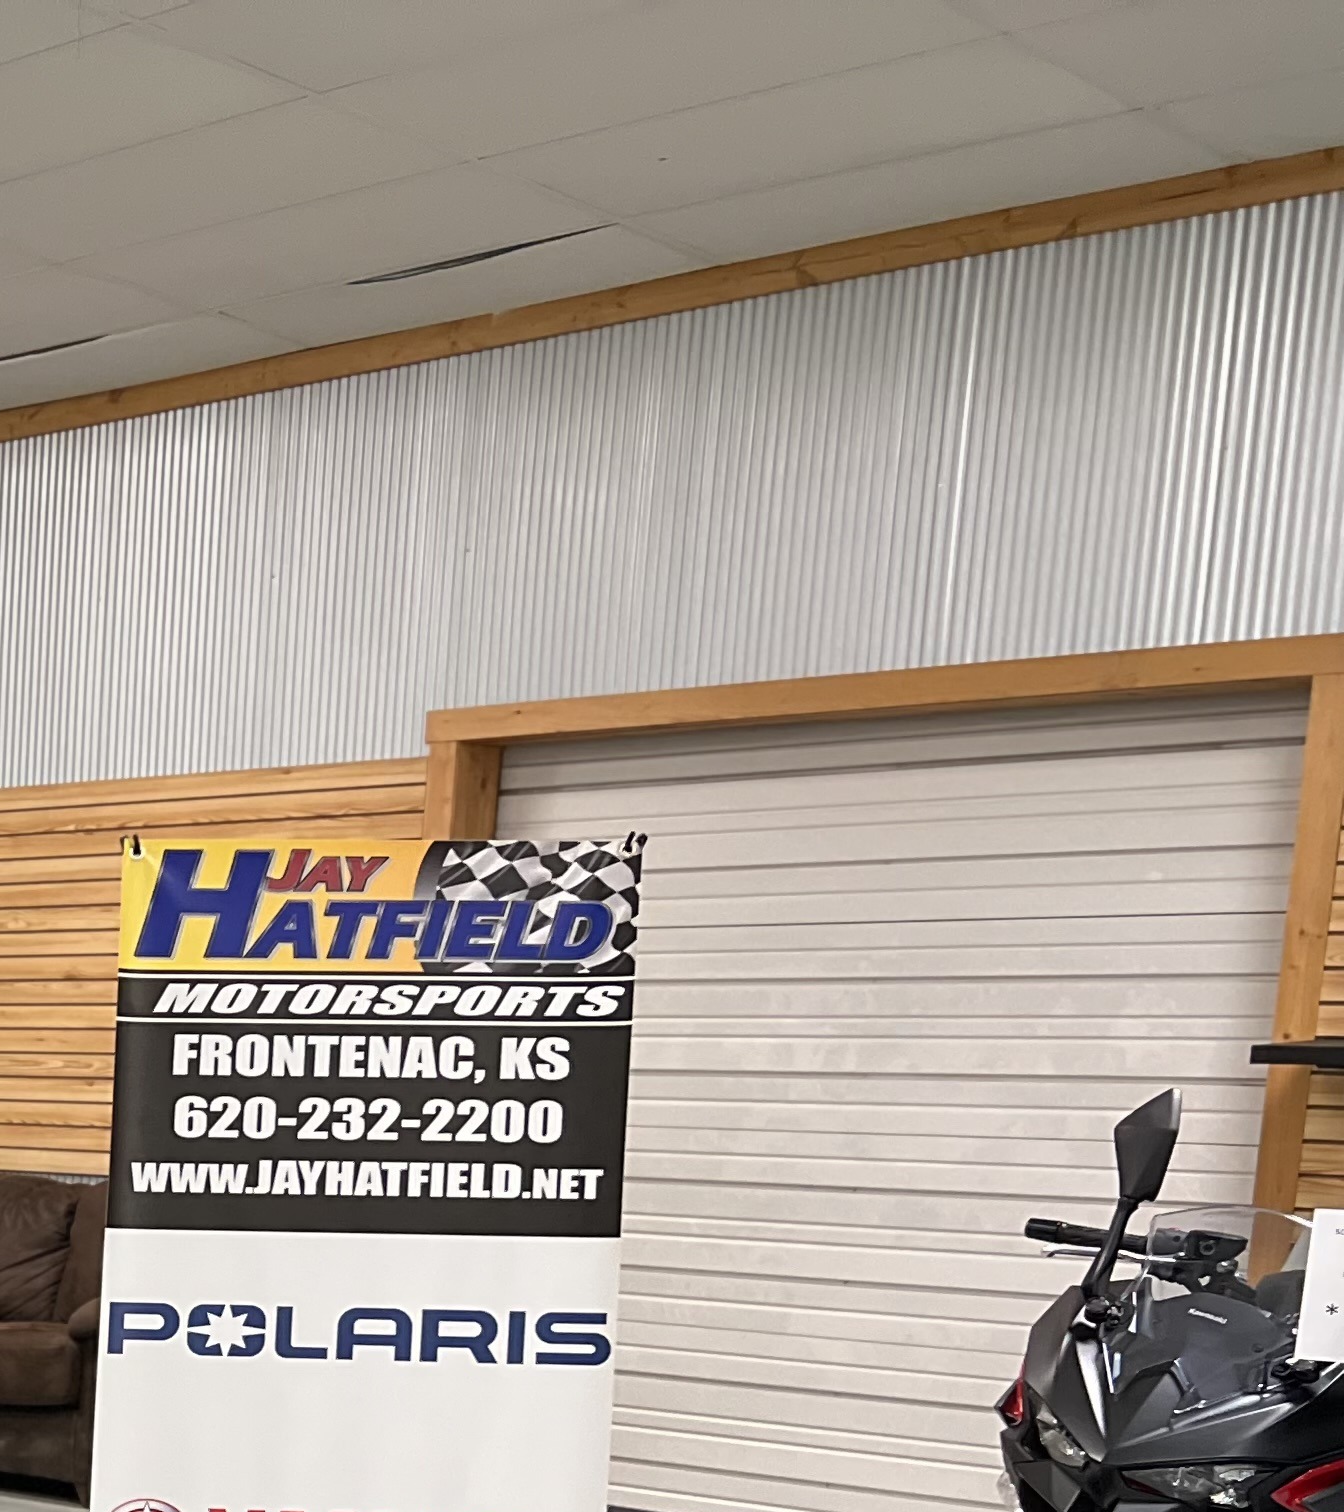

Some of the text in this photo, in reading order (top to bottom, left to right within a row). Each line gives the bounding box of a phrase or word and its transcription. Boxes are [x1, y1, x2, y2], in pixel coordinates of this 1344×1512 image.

[267, 847, 389, 893] JAY
[134, 848, 614, 961] HATFIELD
[152, 983, 625, 1018] MOTORSPORTS
[171, 1034, 571, 1083] FRONTENAC, KS
[172, 1096, 565, 1144] 620-232-2200
[130, 1159, 605, 1200] WWW.JAYHATFIELD.NET
[107, 1302, 612, 1366] POLARIS
